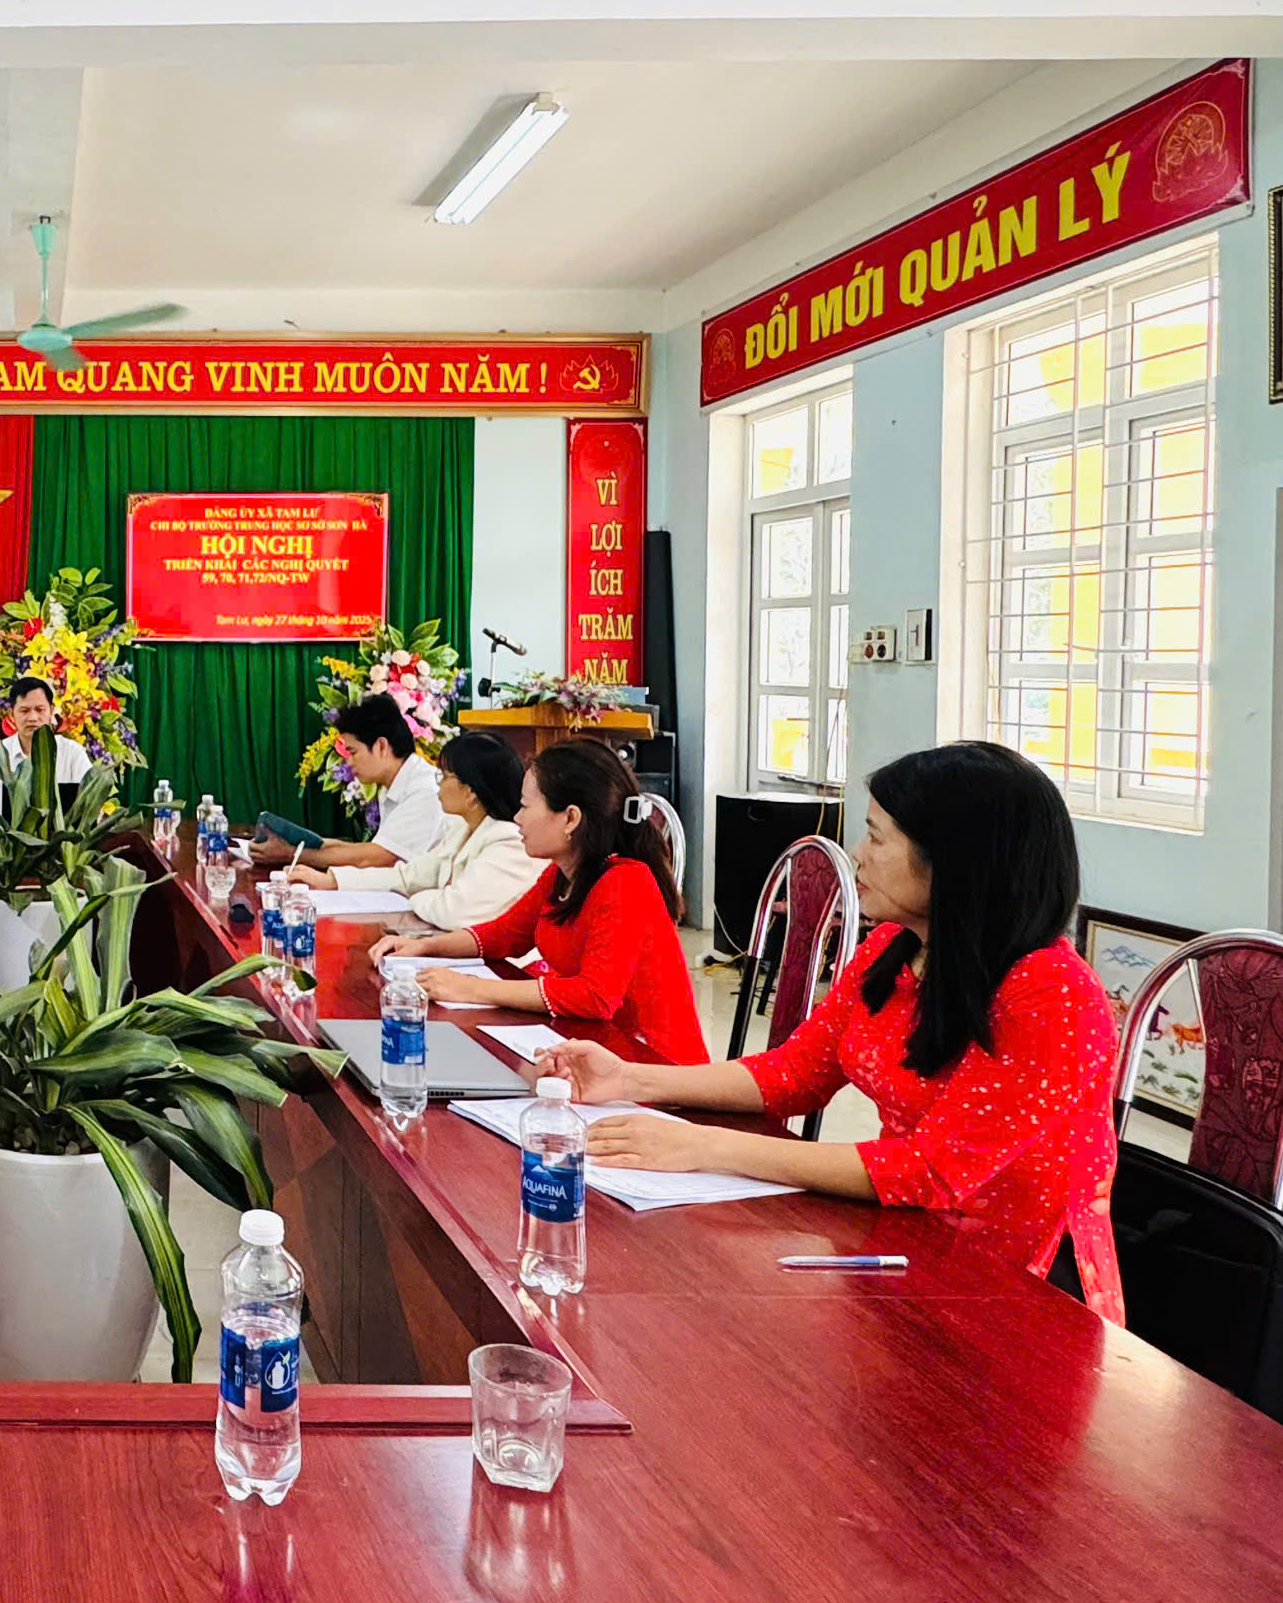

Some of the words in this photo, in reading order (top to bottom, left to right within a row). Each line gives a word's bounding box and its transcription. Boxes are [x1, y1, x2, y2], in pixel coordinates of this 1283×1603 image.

[745, 292, 799, 370] ĐỔI
[810, 259, 885, 344] MỚI
[899, 194, 1038, 307] QUẢN
[1058, 141, 1132, 242] LÝ
[56, 360, 195, 394] QUANG
[205, 361, 304, 393] VINH
[313, 352, 430, 394] MUÔN
[440, 353, 531, 393] NĂM
[597, 471, 618, 506] VÌ
[234, 520, 270, 531] TRUNG
[276, 507, 301, 519] TAM
[201, 533, 246, 559] HỘI
[250, 535, 313, 559] NGHỊ
[590, 520, 623, 557] LỢI
[242, 557, 269, 570] CÁC
[271, 559, 304, 572] NGHỊ
[589, 560, 624, 596] ÍCH
[578, 606, 634, 641] TRĂM
[583, 652, 628, 685] NĂM
